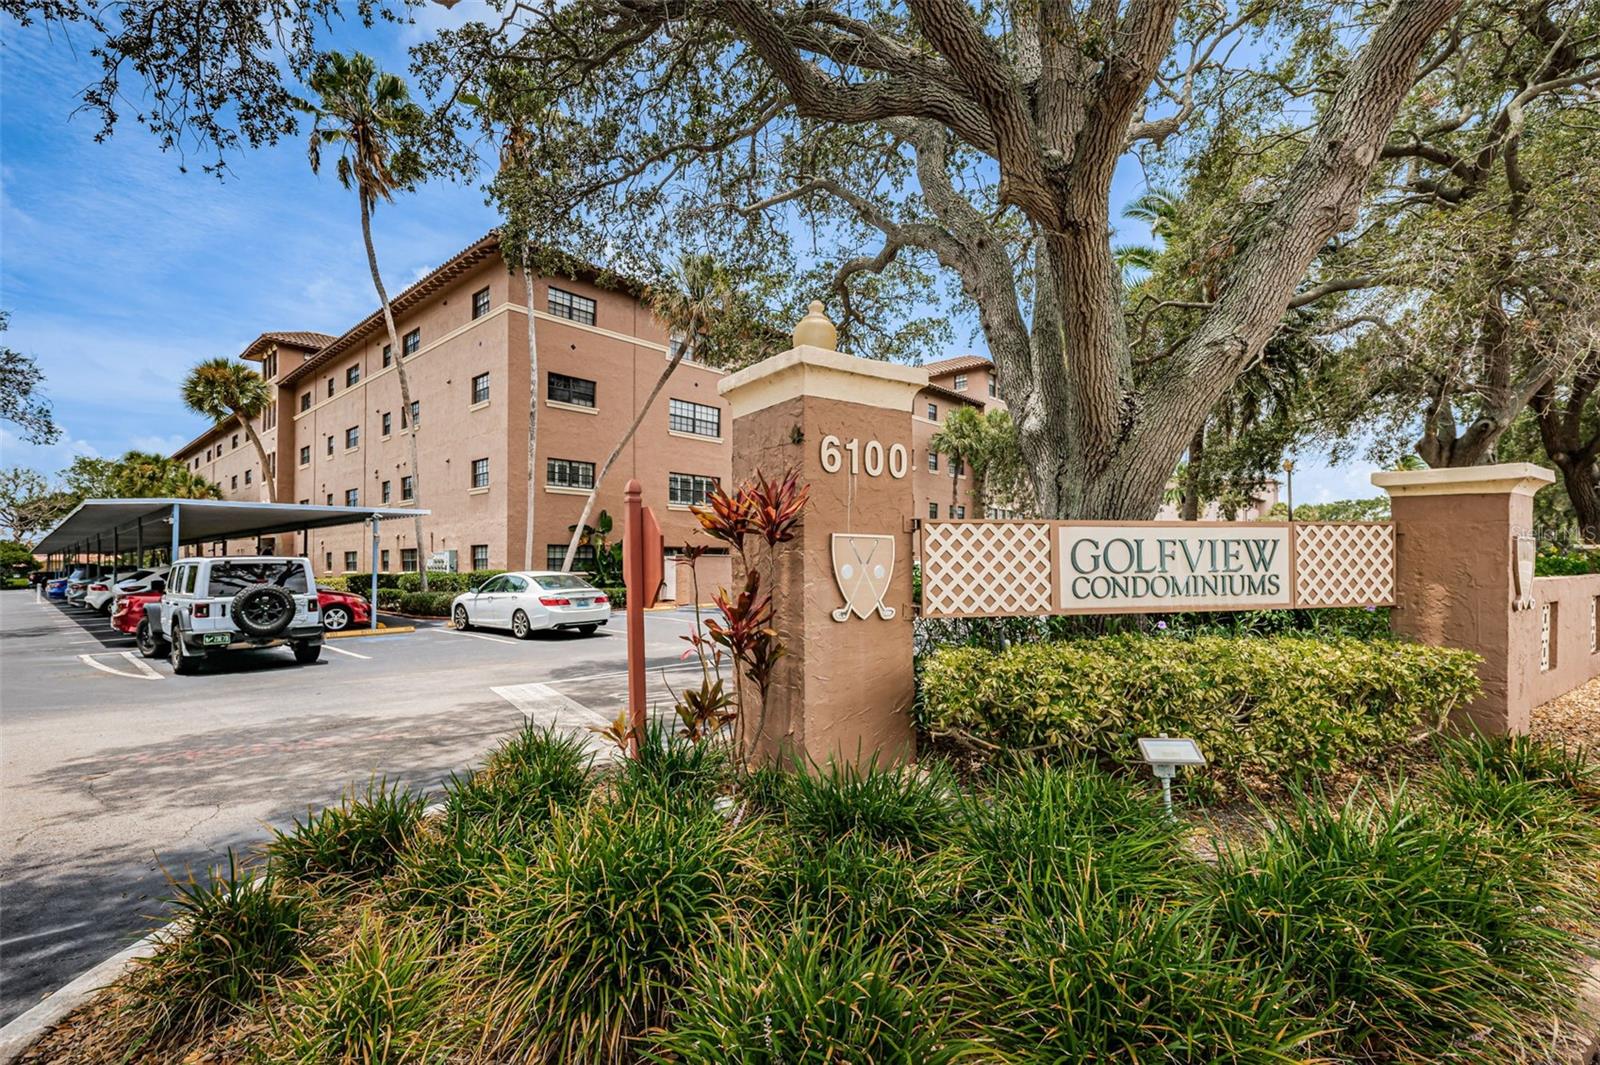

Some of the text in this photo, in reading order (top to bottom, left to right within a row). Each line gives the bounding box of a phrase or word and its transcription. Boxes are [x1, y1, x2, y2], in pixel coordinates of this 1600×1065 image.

[821, 435, 907, 478] 6100
[1071, 538, 1280, 574] GOLFVIEW
[1072, 574, 1280, 599] CONDOMINIUMS
